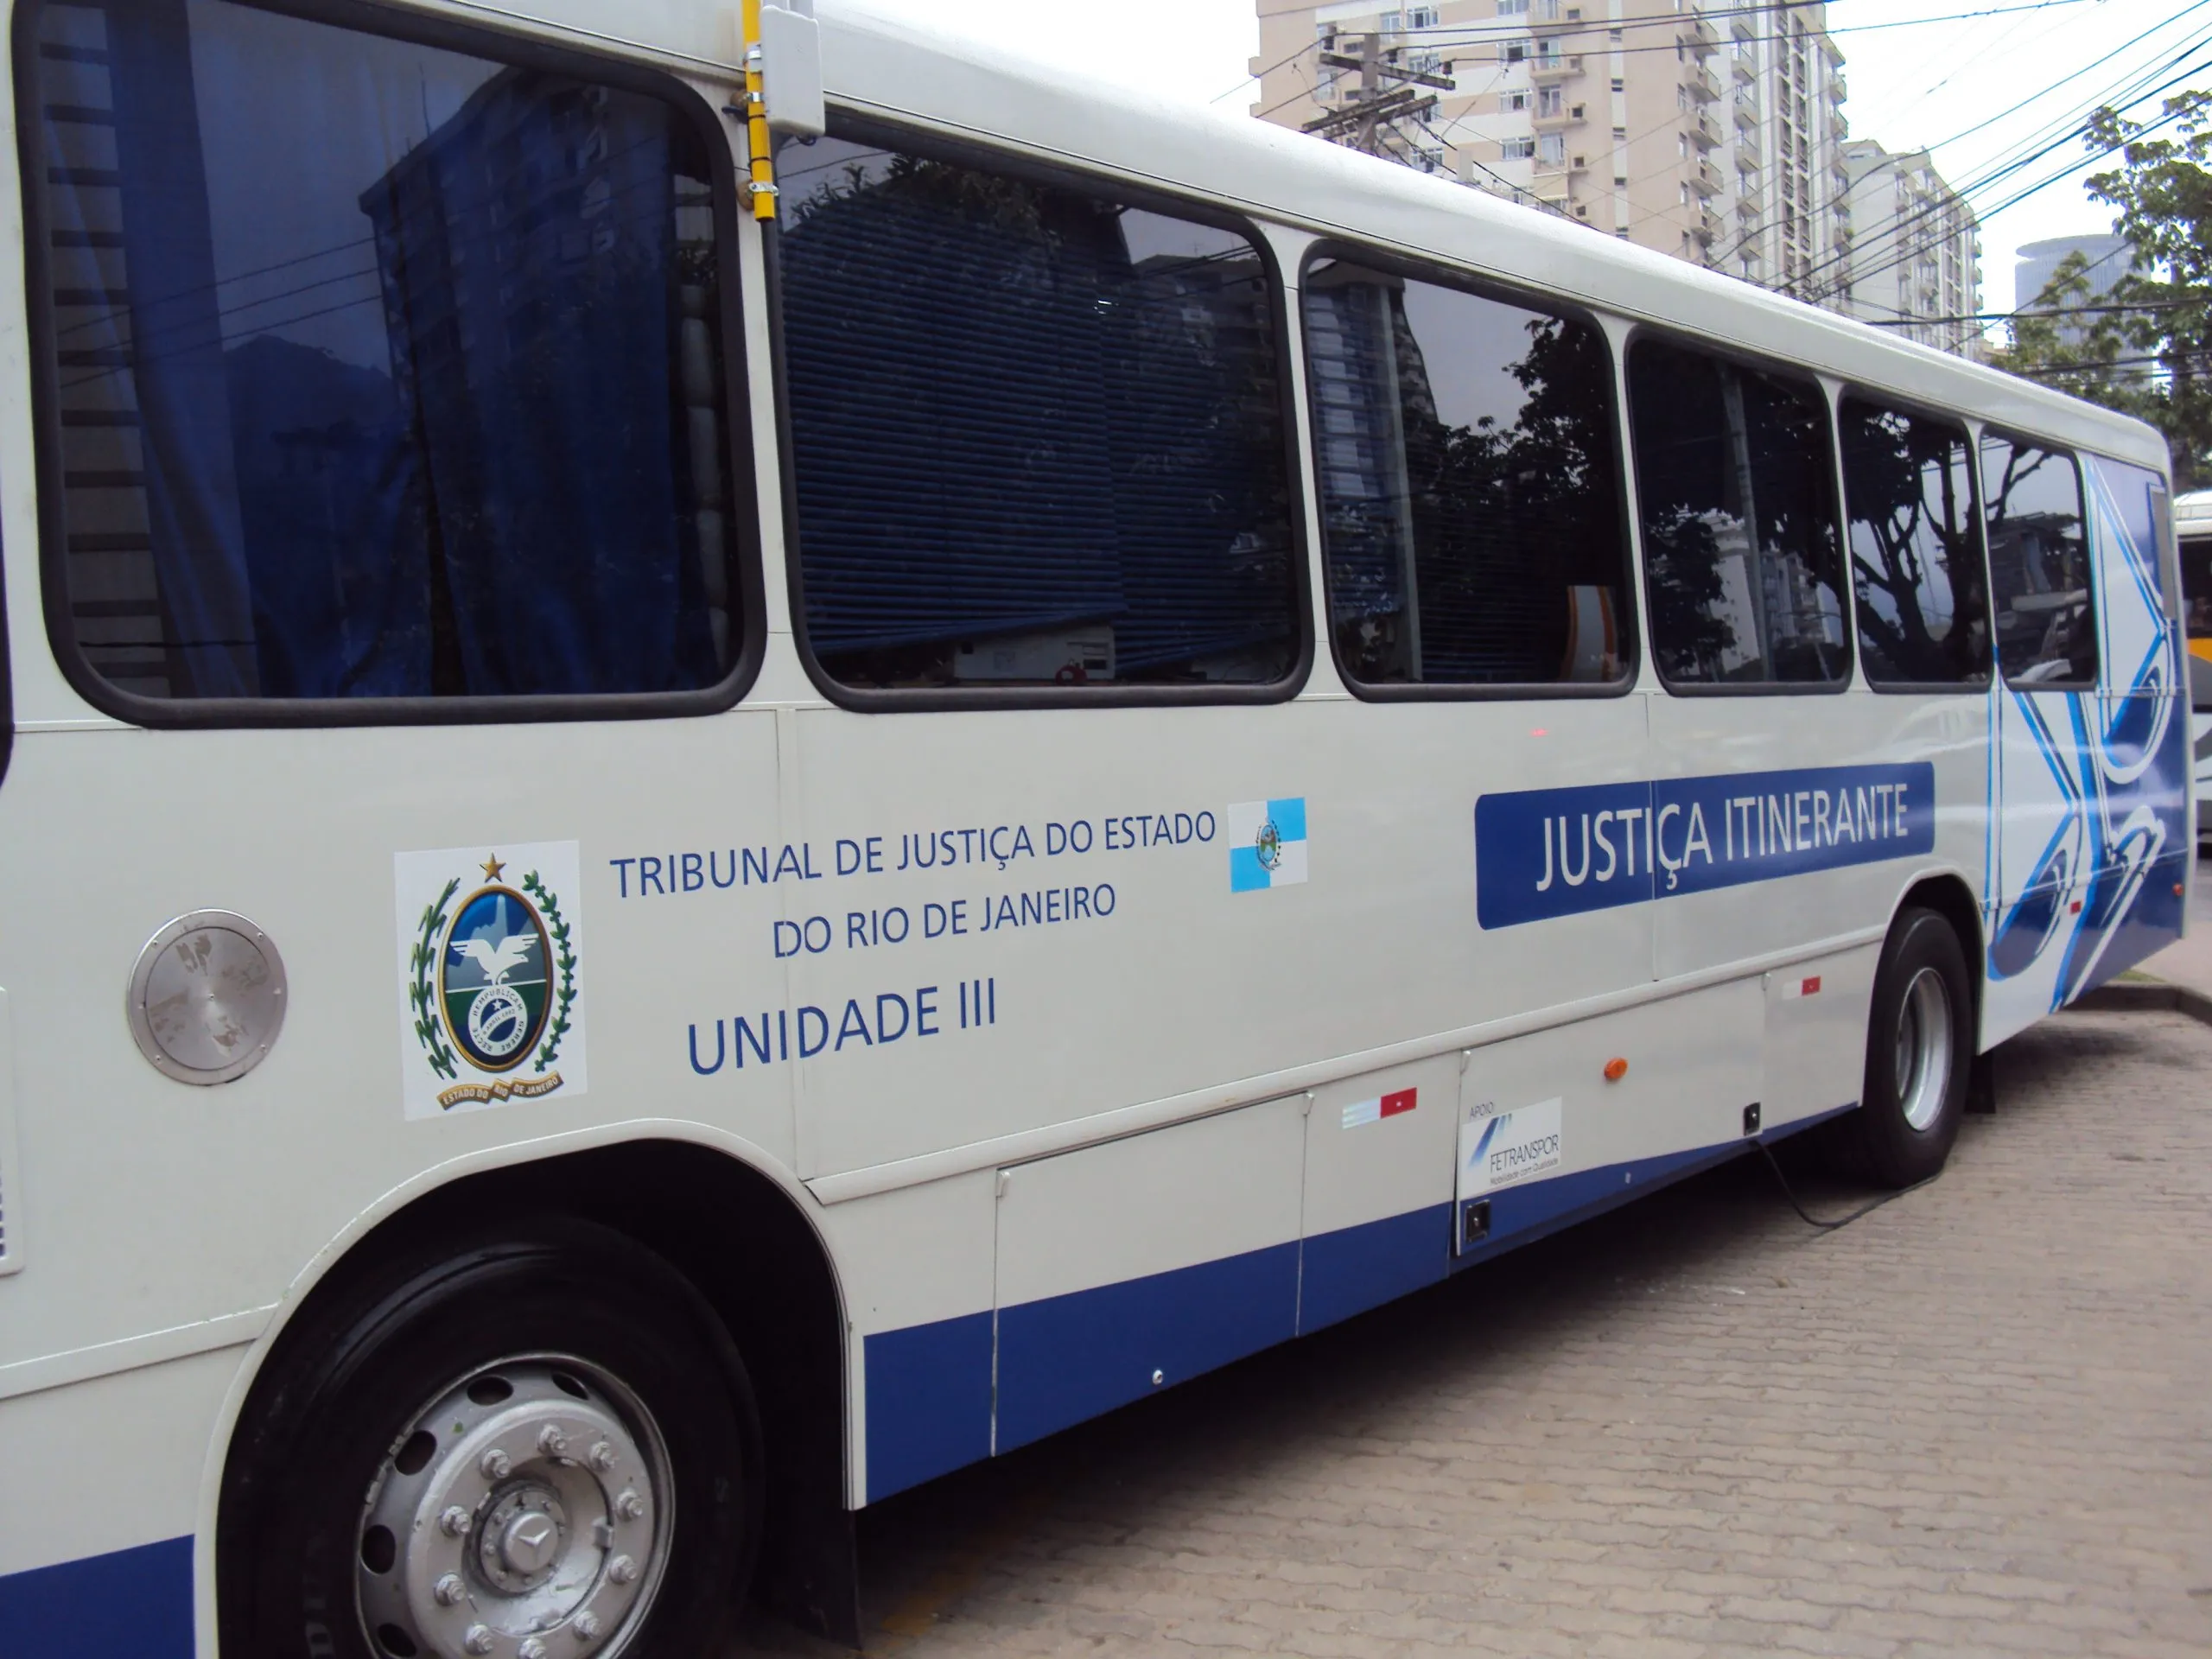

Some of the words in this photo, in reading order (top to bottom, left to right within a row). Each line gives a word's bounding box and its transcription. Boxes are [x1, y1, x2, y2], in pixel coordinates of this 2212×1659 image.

[609, 842, 823, 899] TRIBUNAL
[835, 836, 884, 876] DE
[897, 825, 1035, 871] JUSTIÇA
[1046, 820, 1093, 856] DO
[1105, 810, 1216, 850] ESTADO
[1536, 802, 1713, 892] JUSTIÇA
[1726, 783, 1908, 861] ITINERANTE
[773, 915, 832, 958] DO
[847, 906, 910, 949] RIO
[924, 899, 968, 938] DE
[981, 883, 1116, 932] JANEIRO
[688, 986, 940, 1076] UNIDADE
[959, 977, 995, 1030] III
[443, 1088, 475, 1105] ESTADO
[476, 1089, 489, 1100] DO
[494, 1084, 509, 1097] RIO
[513, 1083, 525, 1095] DE
[525, 1076, 559, 1096] JANEIRO
[1470, 1101, 1494, 1118] APOIO
[1490, 1134, 1559, 1173] FETRANSPOR
